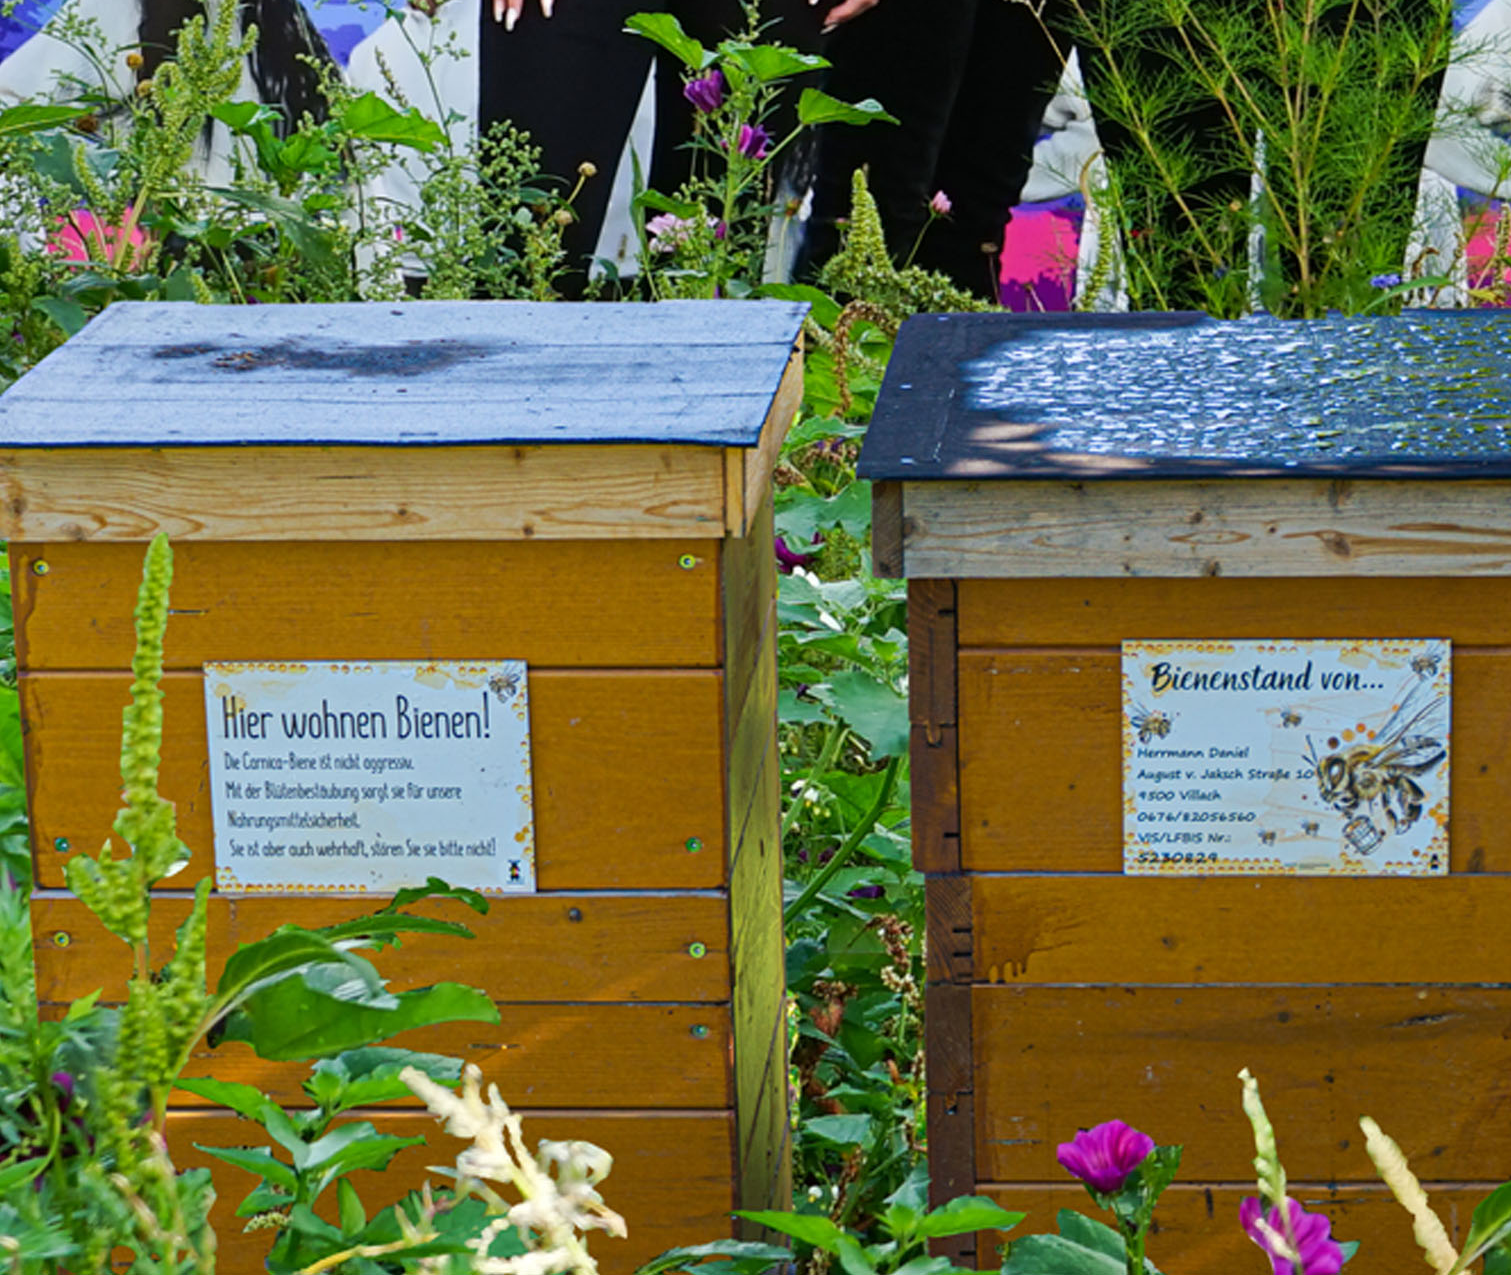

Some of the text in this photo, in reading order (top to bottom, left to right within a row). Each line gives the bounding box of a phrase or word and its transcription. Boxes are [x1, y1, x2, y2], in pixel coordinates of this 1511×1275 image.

[1151, 659, 1384, 693] Bienenstand von...
[222, 691, 491, 740] Hier wohnen Bienen!
[224, 750, 240, 770] Die
[319, 752, 332, 770] ist
[334, 752, 361, 770] nicht
[362, 755, 415, 774] aggressiv.
[1137, 745, 1250, 760] Herrmann Daniel
[1137, 767, 1181, 783] August
[225, 781, 243, 799] Mit
[245, 782, 262, 799] der
[361, 782, 390, 804] sorgt
[390, 785, 405, 800] sie
[406, 781, 425, 800] für
[426, 785, 463, 800] unsere
[1178, 788, 1222, 802] Villach
[229, 838, 245, 857] Sie
[247, 840, 260, 857] ist
[262, 840, 286, 857] aber
[288, 840, 315, 857] auch
[406, 837, 421, 857] Sie
[422, 841, 438, 857] sie
[438, 839, 464, 857] bitte
